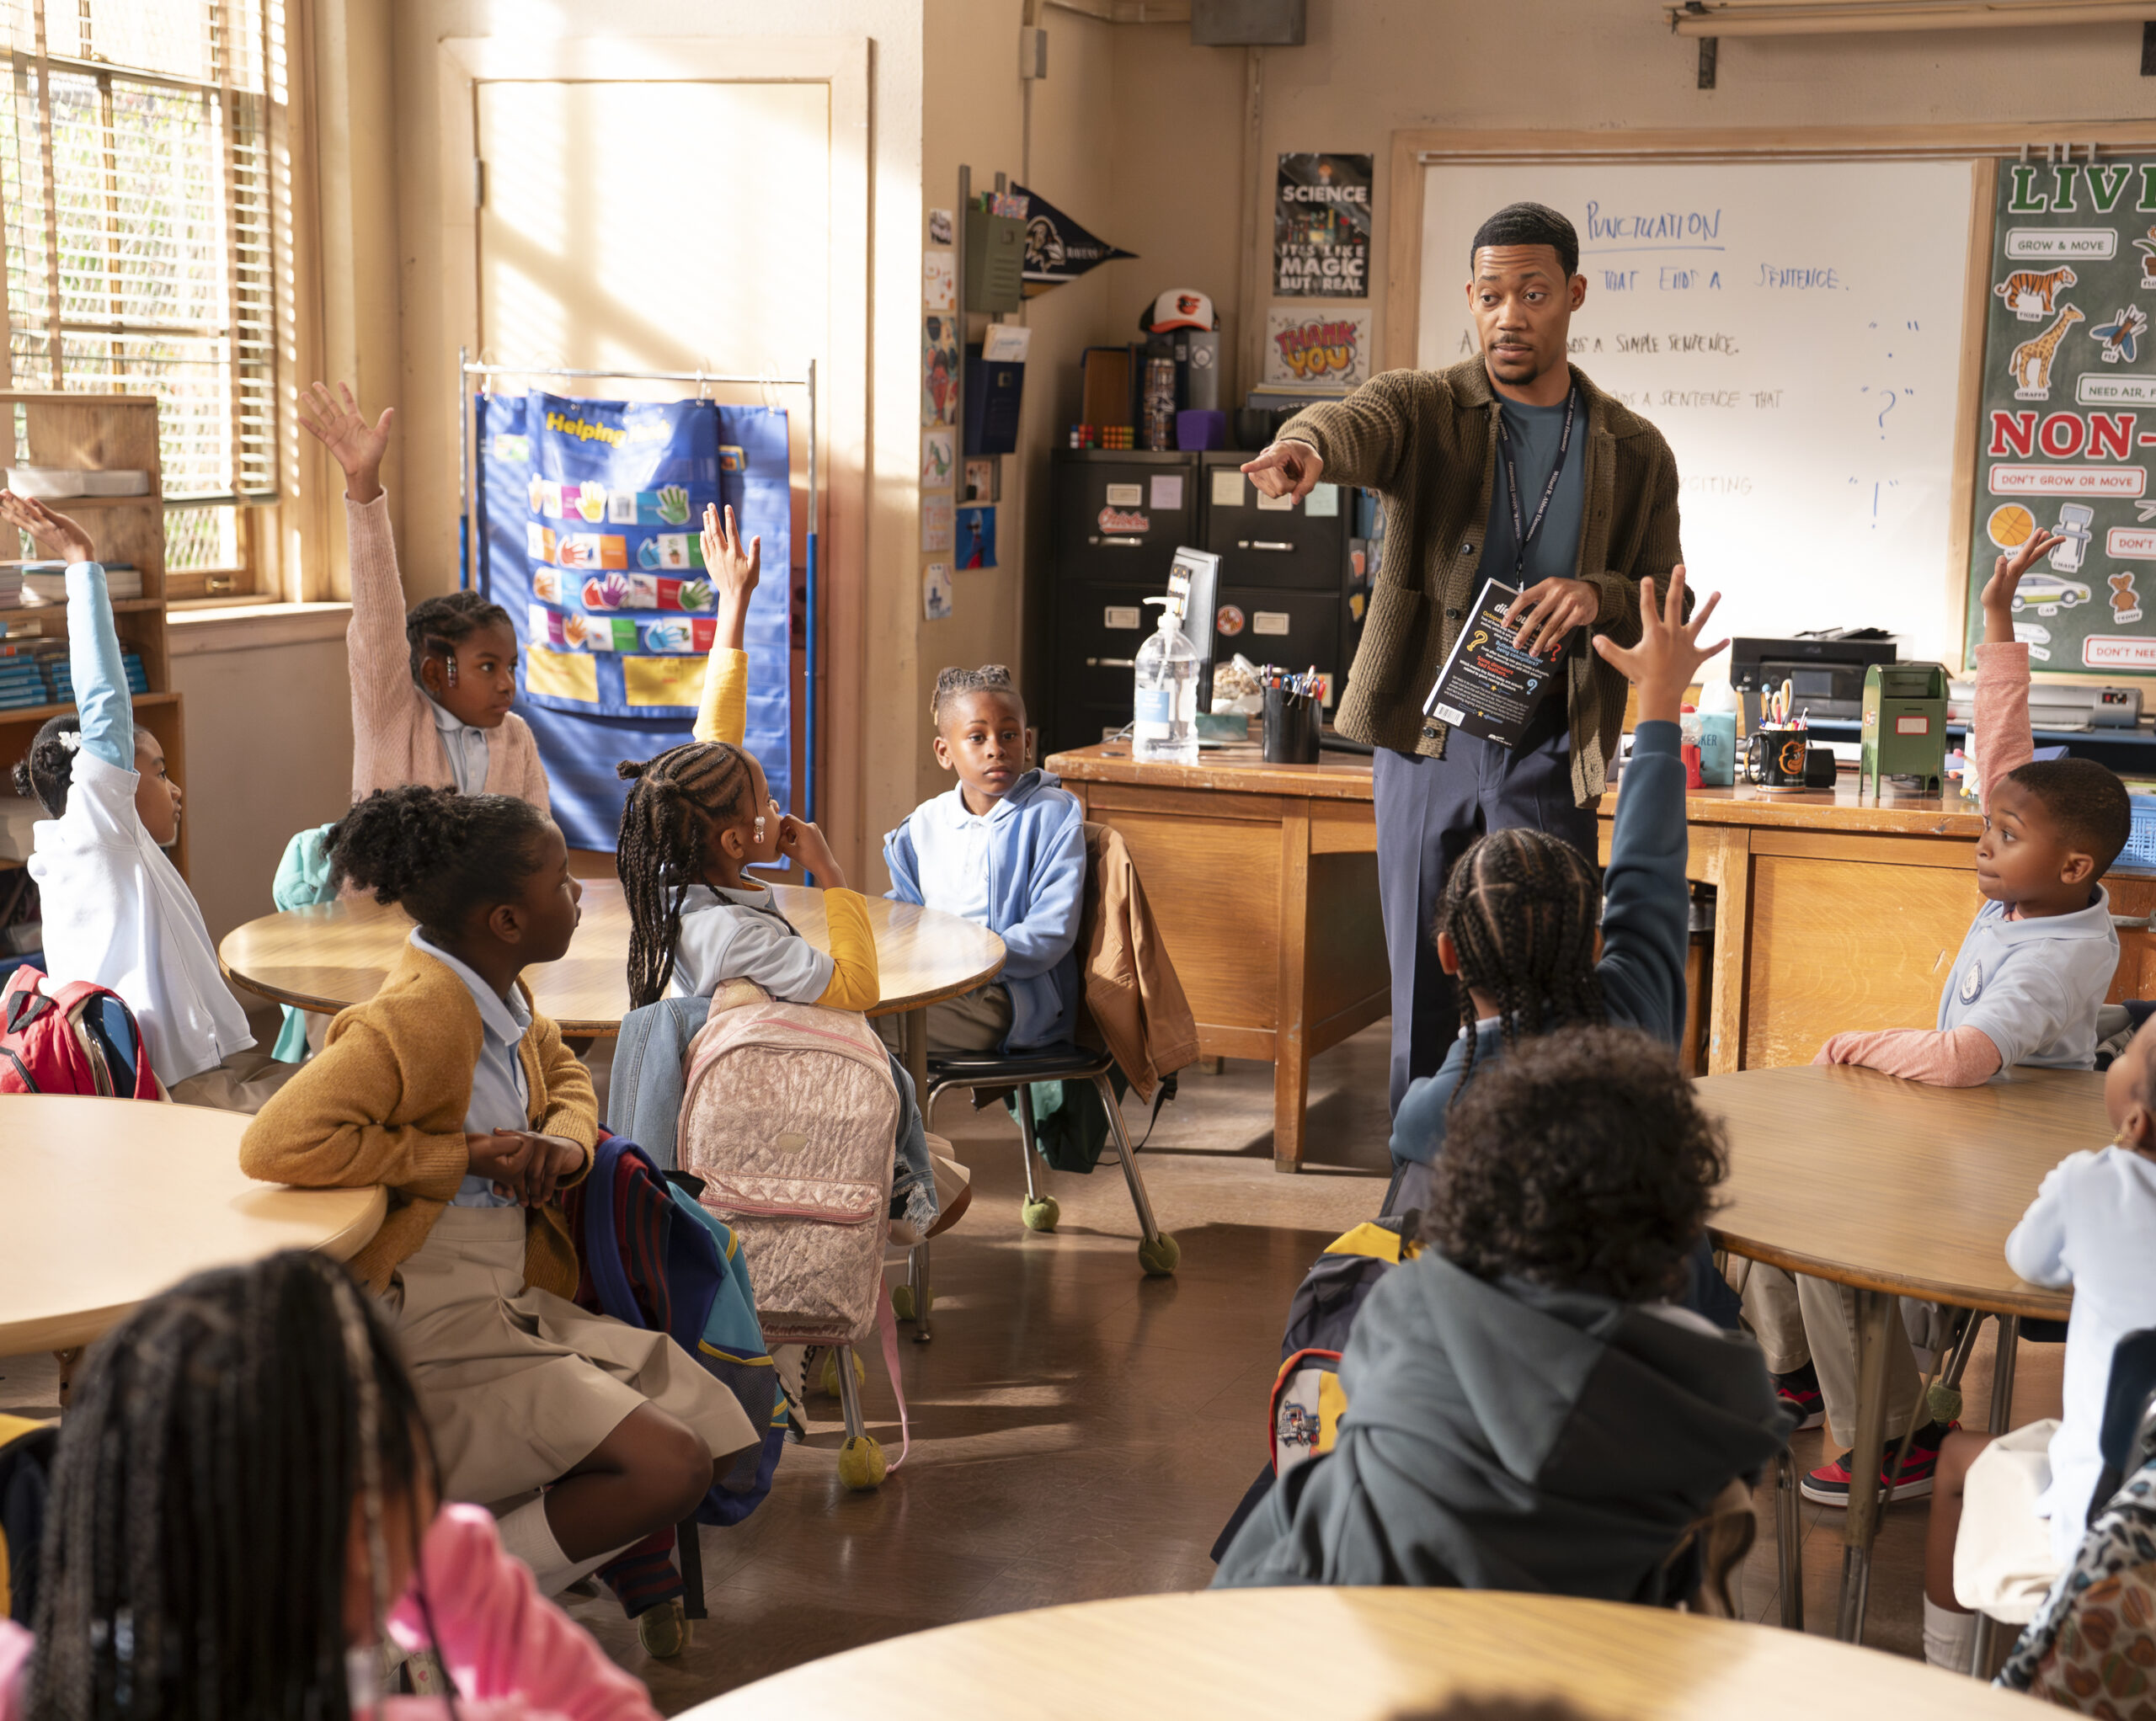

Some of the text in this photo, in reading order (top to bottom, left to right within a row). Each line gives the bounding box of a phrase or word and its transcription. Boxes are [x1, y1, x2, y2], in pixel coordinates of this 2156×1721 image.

[1283, 185, 1368, 203] SCIENCE
[1587, 200, 1721, 241] PUNCTUATION
[1323, 243, 1365, 257] LIKE
[2018, 241, 2105, 251] GROW & MOVE
[1281, 257, 1364, 276] MAGIC
[1280, 276, 1363, 291] BUT REAL
[1600, 269, 1640, 290] THAT
[1710, 271, 1721, 290] A
[1275, 320, 1358, 353] THANK
[1593, 336, 1603, 354] A
[1287, 345, 1349, 378] YOU
[1749, 389, 1784, 409] THAT
[2089, 386, 2117, 397] NEED
[547, 412, 627, 449] Helping
[2002, 475, 2133, 487] DON'T GROW OR MOVE
[2119, 538, 2154, 549] DON'T
[1496, 646, 1510, 656] being
[2096, 647, 2132, 658] DON'T
[1476, 654, 1514, 674] Some dinosaurs
[1698, 734, 1717, 747] KER
